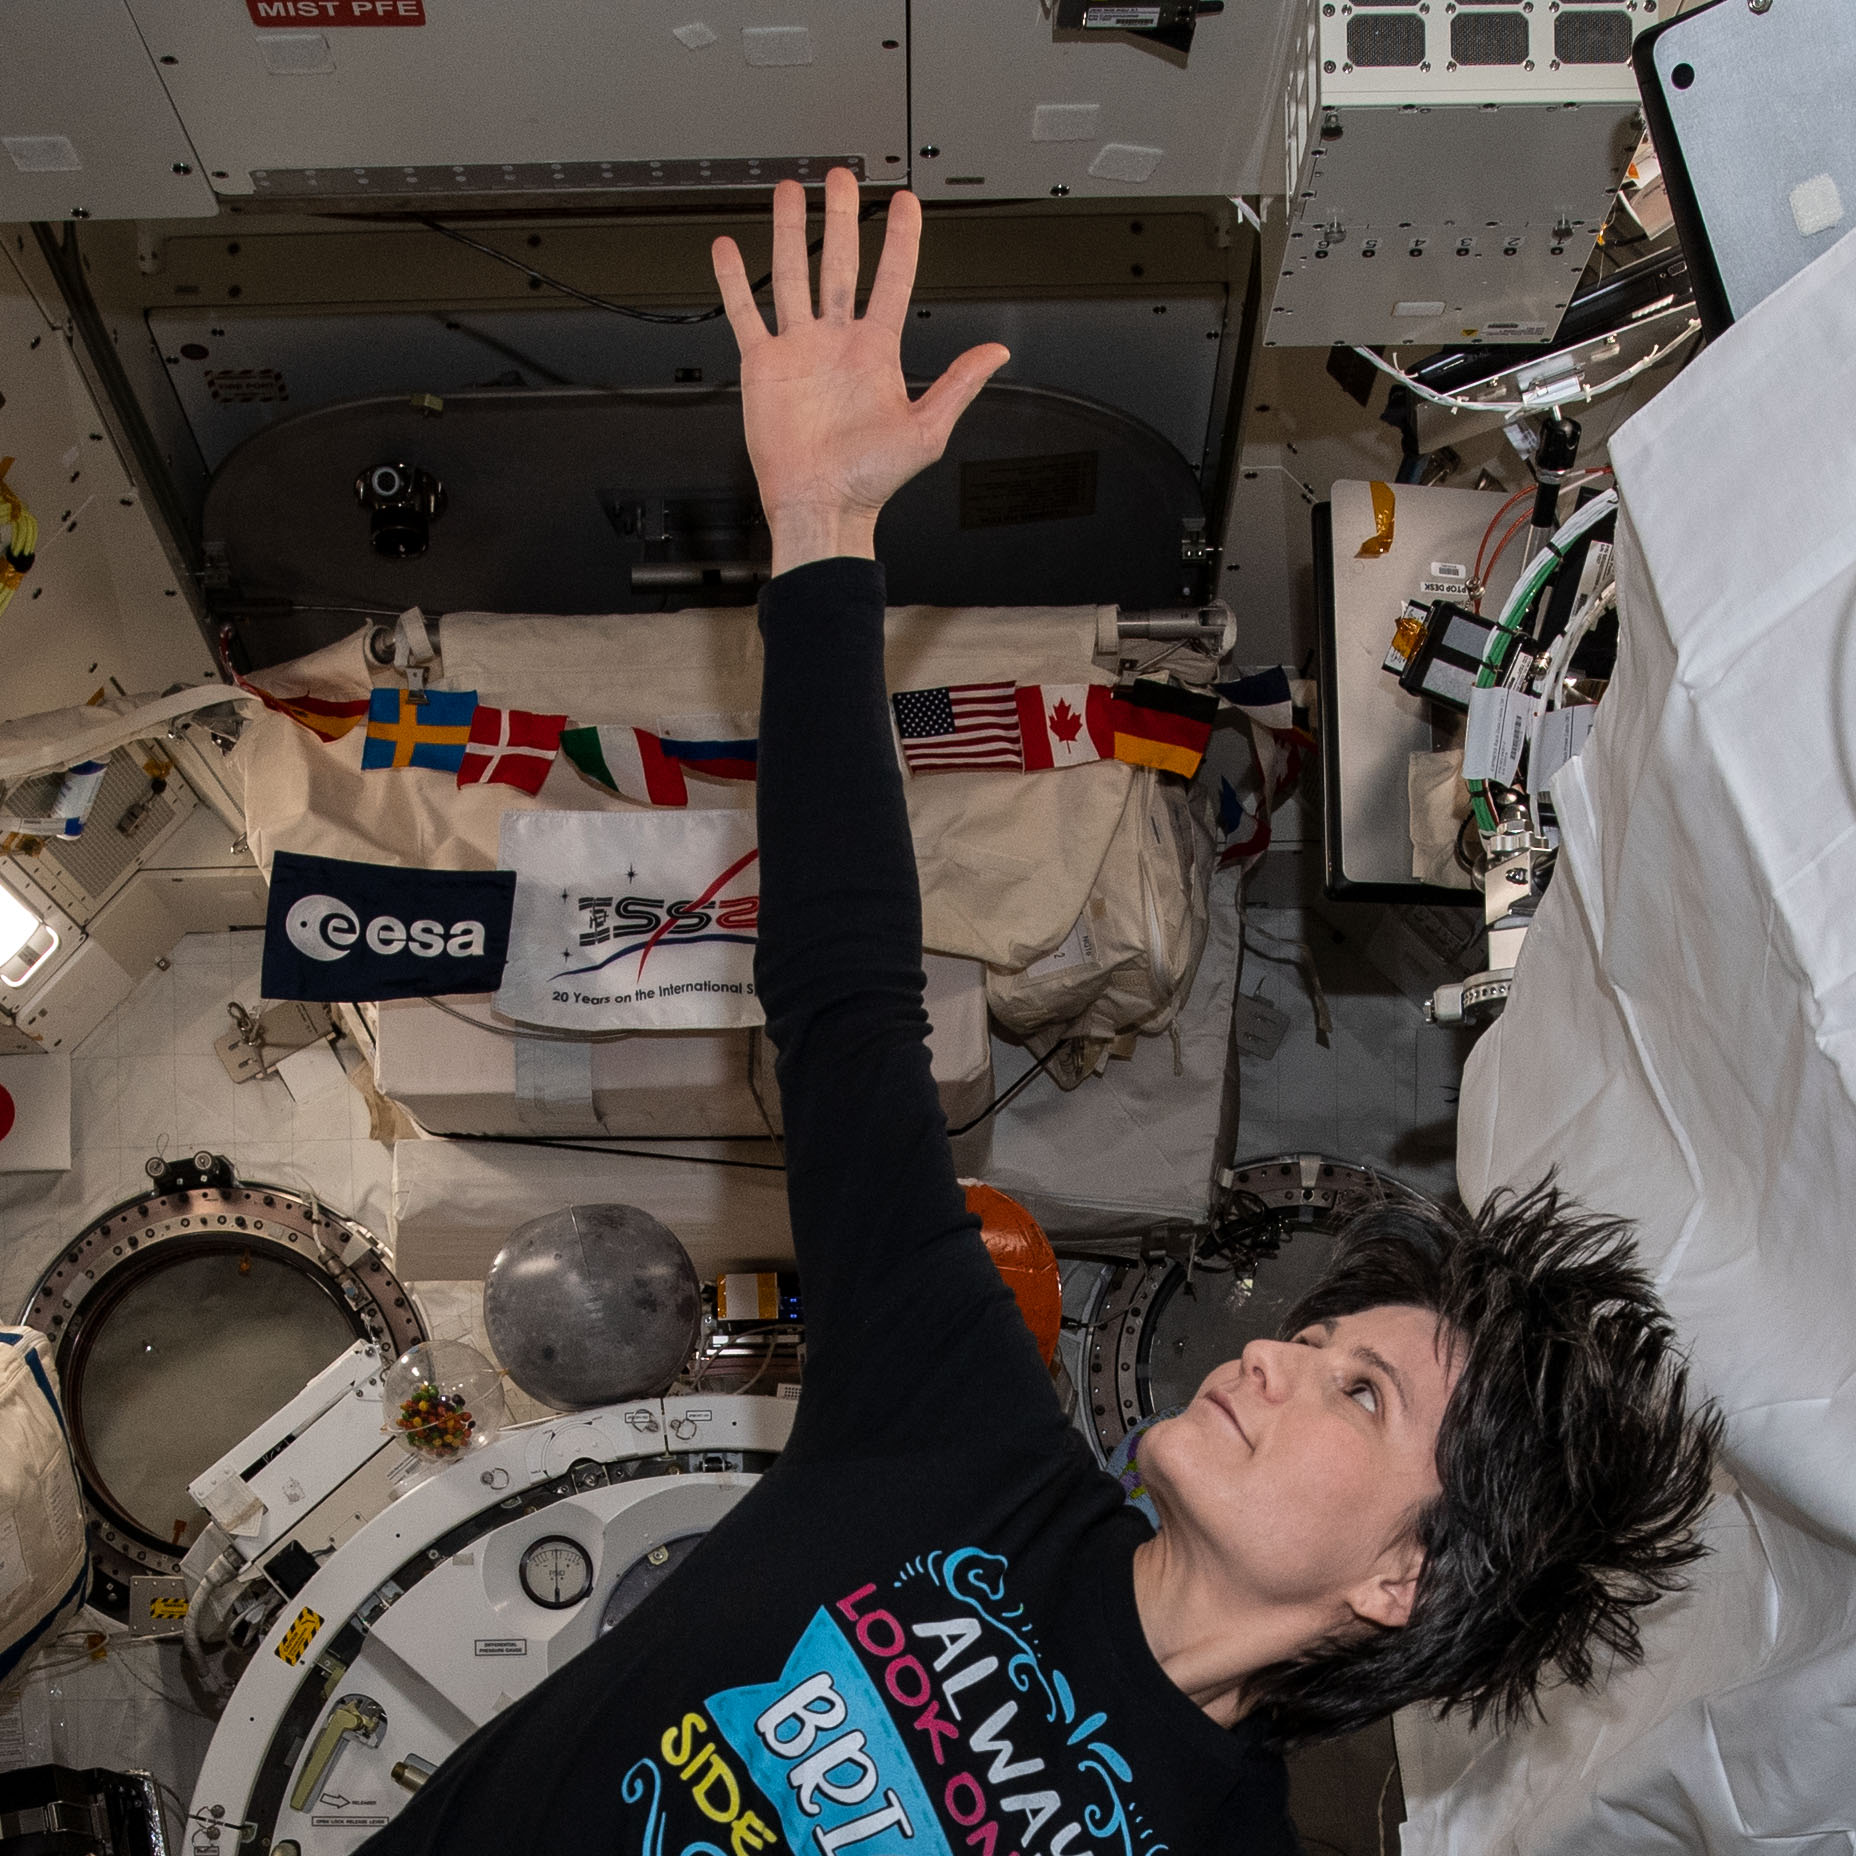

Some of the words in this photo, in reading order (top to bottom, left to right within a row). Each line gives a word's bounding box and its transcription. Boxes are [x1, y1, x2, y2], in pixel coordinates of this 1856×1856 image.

[258, 0, 334, 17] MIST
[352, 0, 419, 16] PFE
[1424, 583, 1446, 592] DESK
[1448, 583, 1466, 593] PTOP
[366, 913, 486, 959] esa
[552, 991, 570, 1002] 20
[573, 991, 611, 1006] Years
[614, 996, 630, 1006] on
[635, 987, 654, 1001] the
[659, 979, 743, 998] International
[836, 1583, 959, 1765] LOOK
